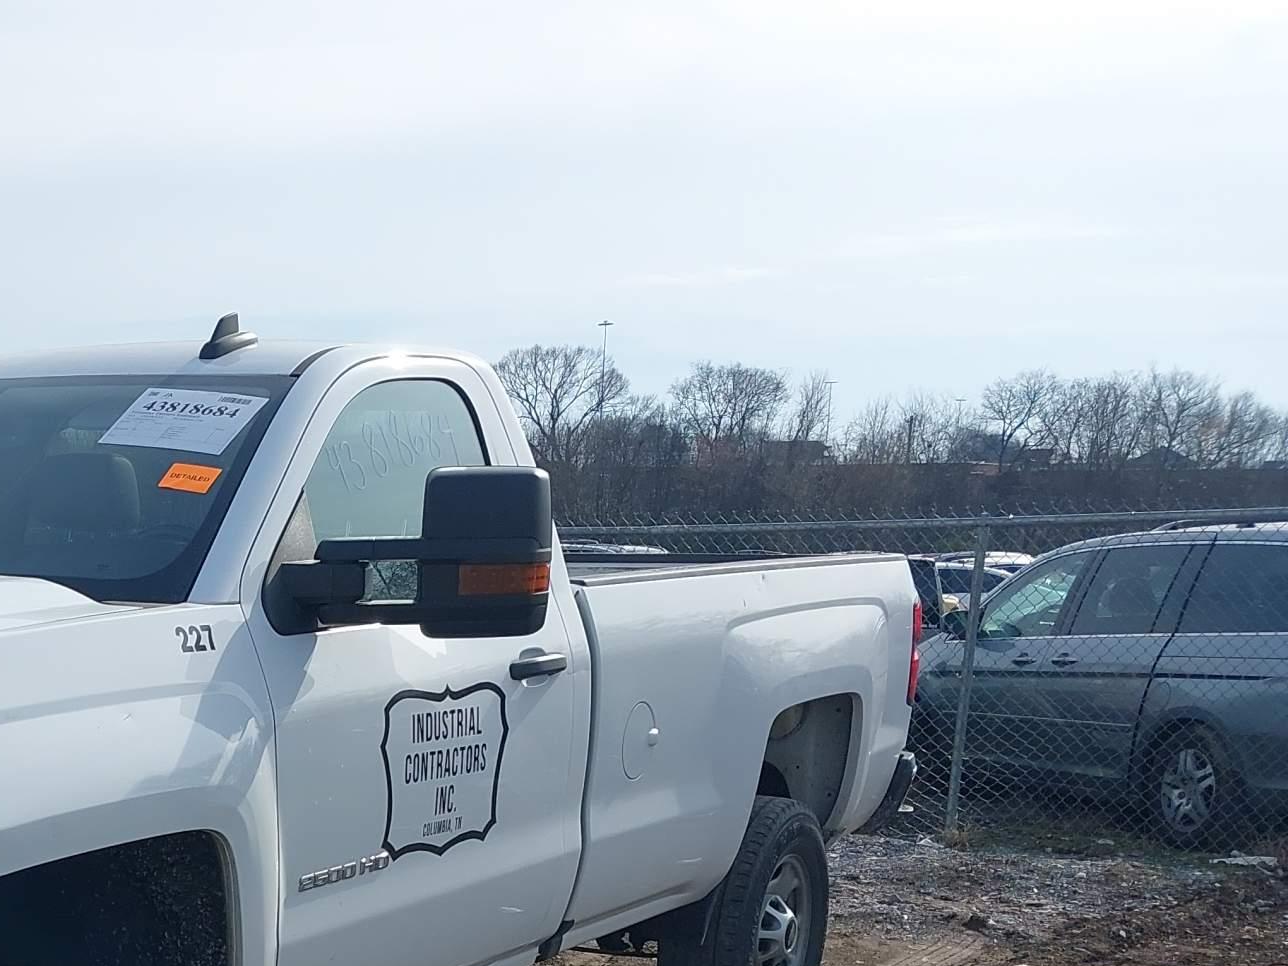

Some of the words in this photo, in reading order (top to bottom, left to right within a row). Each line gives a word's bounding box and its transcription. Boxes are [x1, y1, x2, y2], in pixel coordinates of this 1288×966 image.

[142, 400, 241, 419] 43818684
[169, 472, 211, 483] DETAILED
[175, 624, 216, 653] 227
[412, 706, 483, 744] INDUSTRIAL
[404, 743, 488, 785] CONTRACTORS
[434, 784, 457, 816] INC.
[454, 815, 463, 831] TN
[298, 861, 357, 893] 2500
[359, 850, 390, 876] HD
